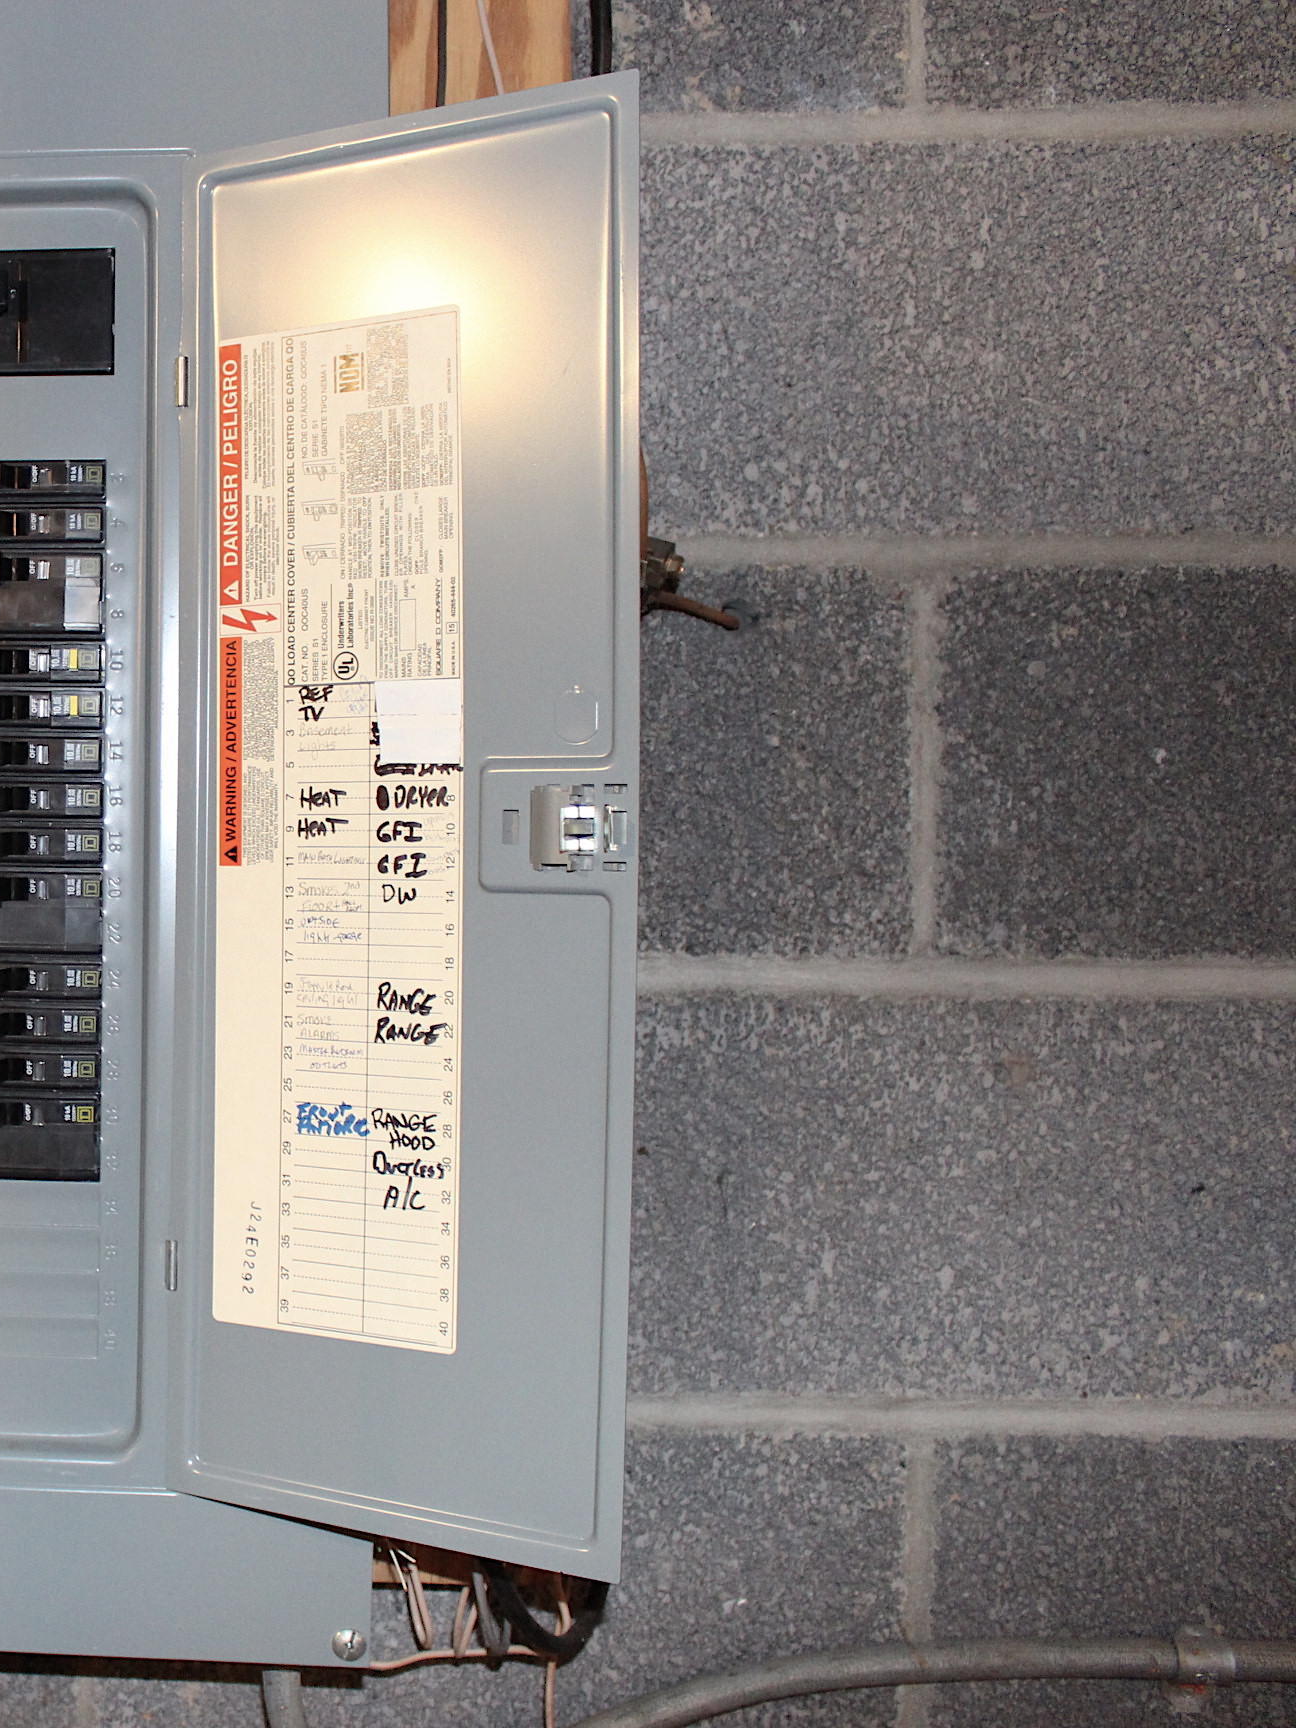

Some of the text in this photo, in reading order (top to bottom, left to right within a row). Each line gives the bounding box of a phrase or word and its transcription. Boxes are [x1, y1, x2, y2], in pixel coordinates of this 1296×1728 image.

[286, 337, 295, 356] QO
[286, 357, 295, 396] CARGA
[221, 360, 239, 455] PELIGRO
[286, 397, 295, 413] DE
[286, 415, 295, 460] CENTRO
[287, 461, 295, 484] DEL
[222, 474, 239, 567] DANGER
[287, 486, 296, 540] CUBIERTA
[287, 548, 296, 586] COVER
[287, 590, 296, 633] CENTER
[321, 600, 329, 651] ENCLOSURE
[337, 601, 346, 649] Underwriters
[346, 600, 355, 649] Laboratories
[287, 636, 296, 666] LOAD
[287, 669, 296, 686] QO
[321, 659, 329, 682] TYPE
[224, 640, 237, 753] ADVERTENCIA
[299, 684, 333, 704] REF
[298, 705, 324, 721] TV
[286, 729, 294, 737] 3
[286, 761, 294, 769] 5
[225, 766, 237, 842] WARNING
[286, 793, 295, 801] 7
[376, 821, 423, 843] GFI
[446, 822, 456, 836] 10
[29, 835, 37, 850] OFF
[286, 856, 294, 866] 11
[377, 853, 428, 878] GFI
[446, 856, 455, 869] 12
[29, 879, 37, 894] OFF
[285, 886, 294, 899] 13
[382, 883, 417, 905] DW
[445, 890, 455, 904] 14
[285, 918, 294, 931] 15
[445, 924, 454, 937] 16
[285, 950, 294, 962] 17
[445, 957, 454, 970] 18
[284, 981, 293, 995] 19
[377, 981, 437, 1015] RANGE
[444, 991, 454, 1005] 20
[26, 1015, 34, 1030] OFF
[284, 1015, 293, 1028] 21
[374, 1017, 447, 1046] RANGE
[284, 1045, 292, 1060] 23
[25, 1061, 33, 1076] OFF
[443, 1058, 453, 1072] 24
[283, 1077, 292, 1092] 25
[443, 1091, 452, 1105] 26
[283, 1109, 292, 1124] 27
[372, 1107, 437, 1132] RANGE
[443, 1124, 452, 1138] 28
[390, 1129, 435, 1151] HOOD
[282, 1141, 291, 1155] 29
[282, 1173, 291, 1186] 31
[383, 1175, 425, 1211] A/C
[441, 1191, 451, 1204] 32
[281, 1202, 291, 1216] 33
[441, 1222, 450, 1235] 34
[281, 1234, 290, 1248] 35
[441, 1255, 450, 1269] 36
[281, 1266, 290, 1280] 37
[440, 1288, 449, 1302] 38
[280, 1298, 289, 1313] 39
[439, 1321, 449, 1336] 40
